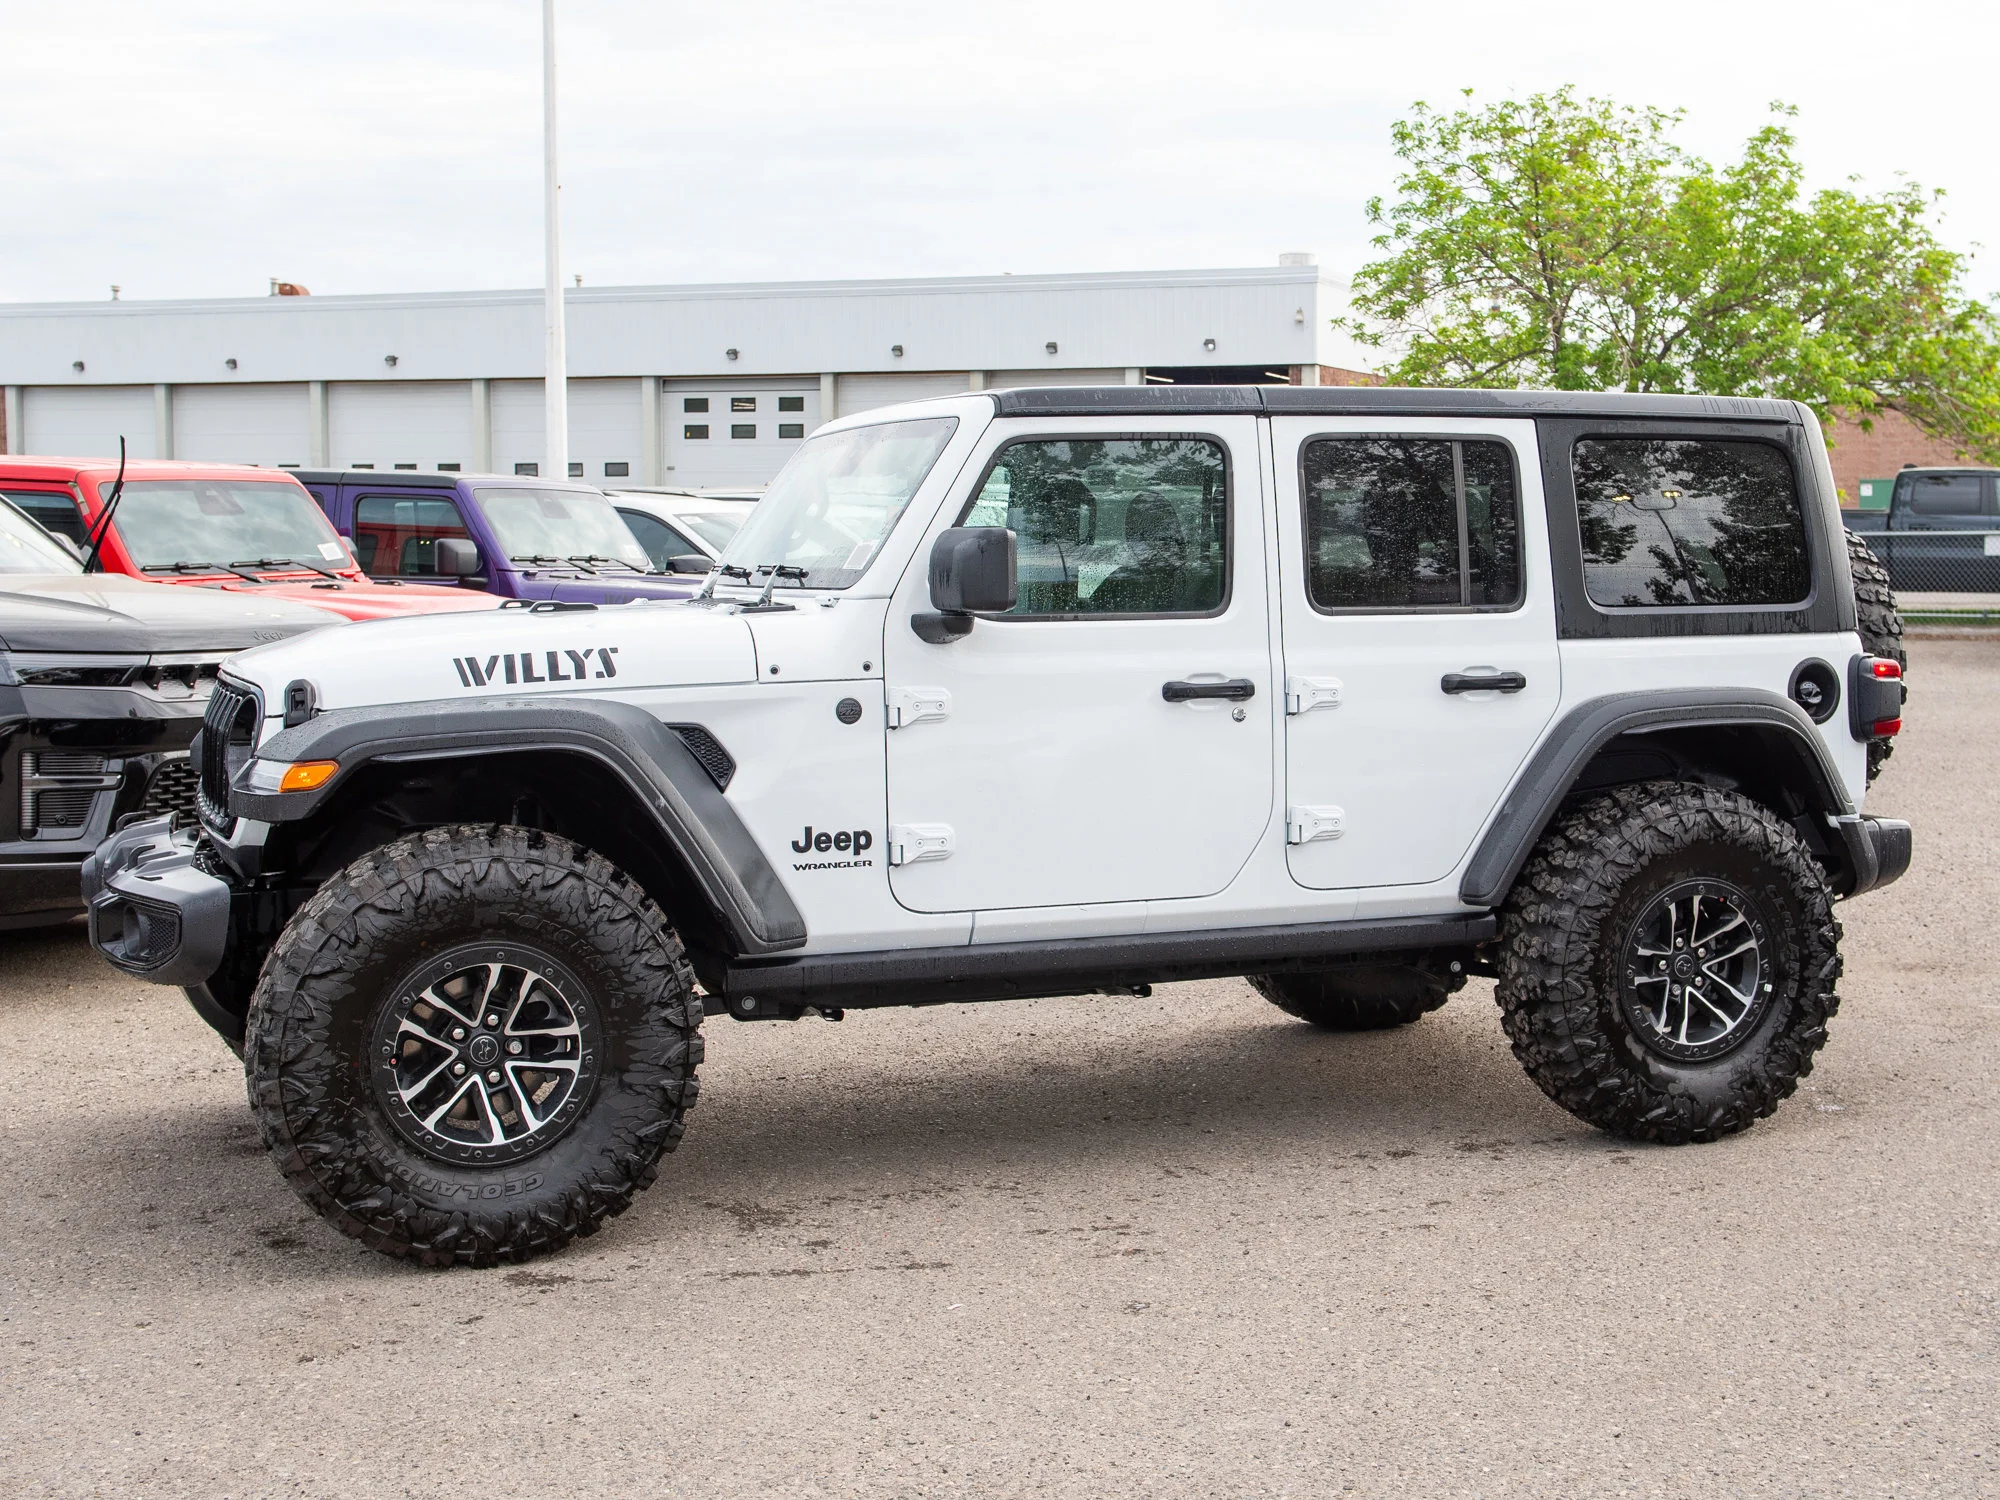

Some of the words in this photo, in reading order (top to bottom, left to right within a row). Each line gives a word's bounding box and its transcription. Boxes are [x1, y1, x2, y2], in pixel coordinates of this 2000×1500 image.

[452, 647, 618, 687] WILLYS
[791, 825, 872, 855] Jeep
[793, 860, 873, 871] WRANGLER
[356, 1130, 545, 1200] GEOLANDAR
